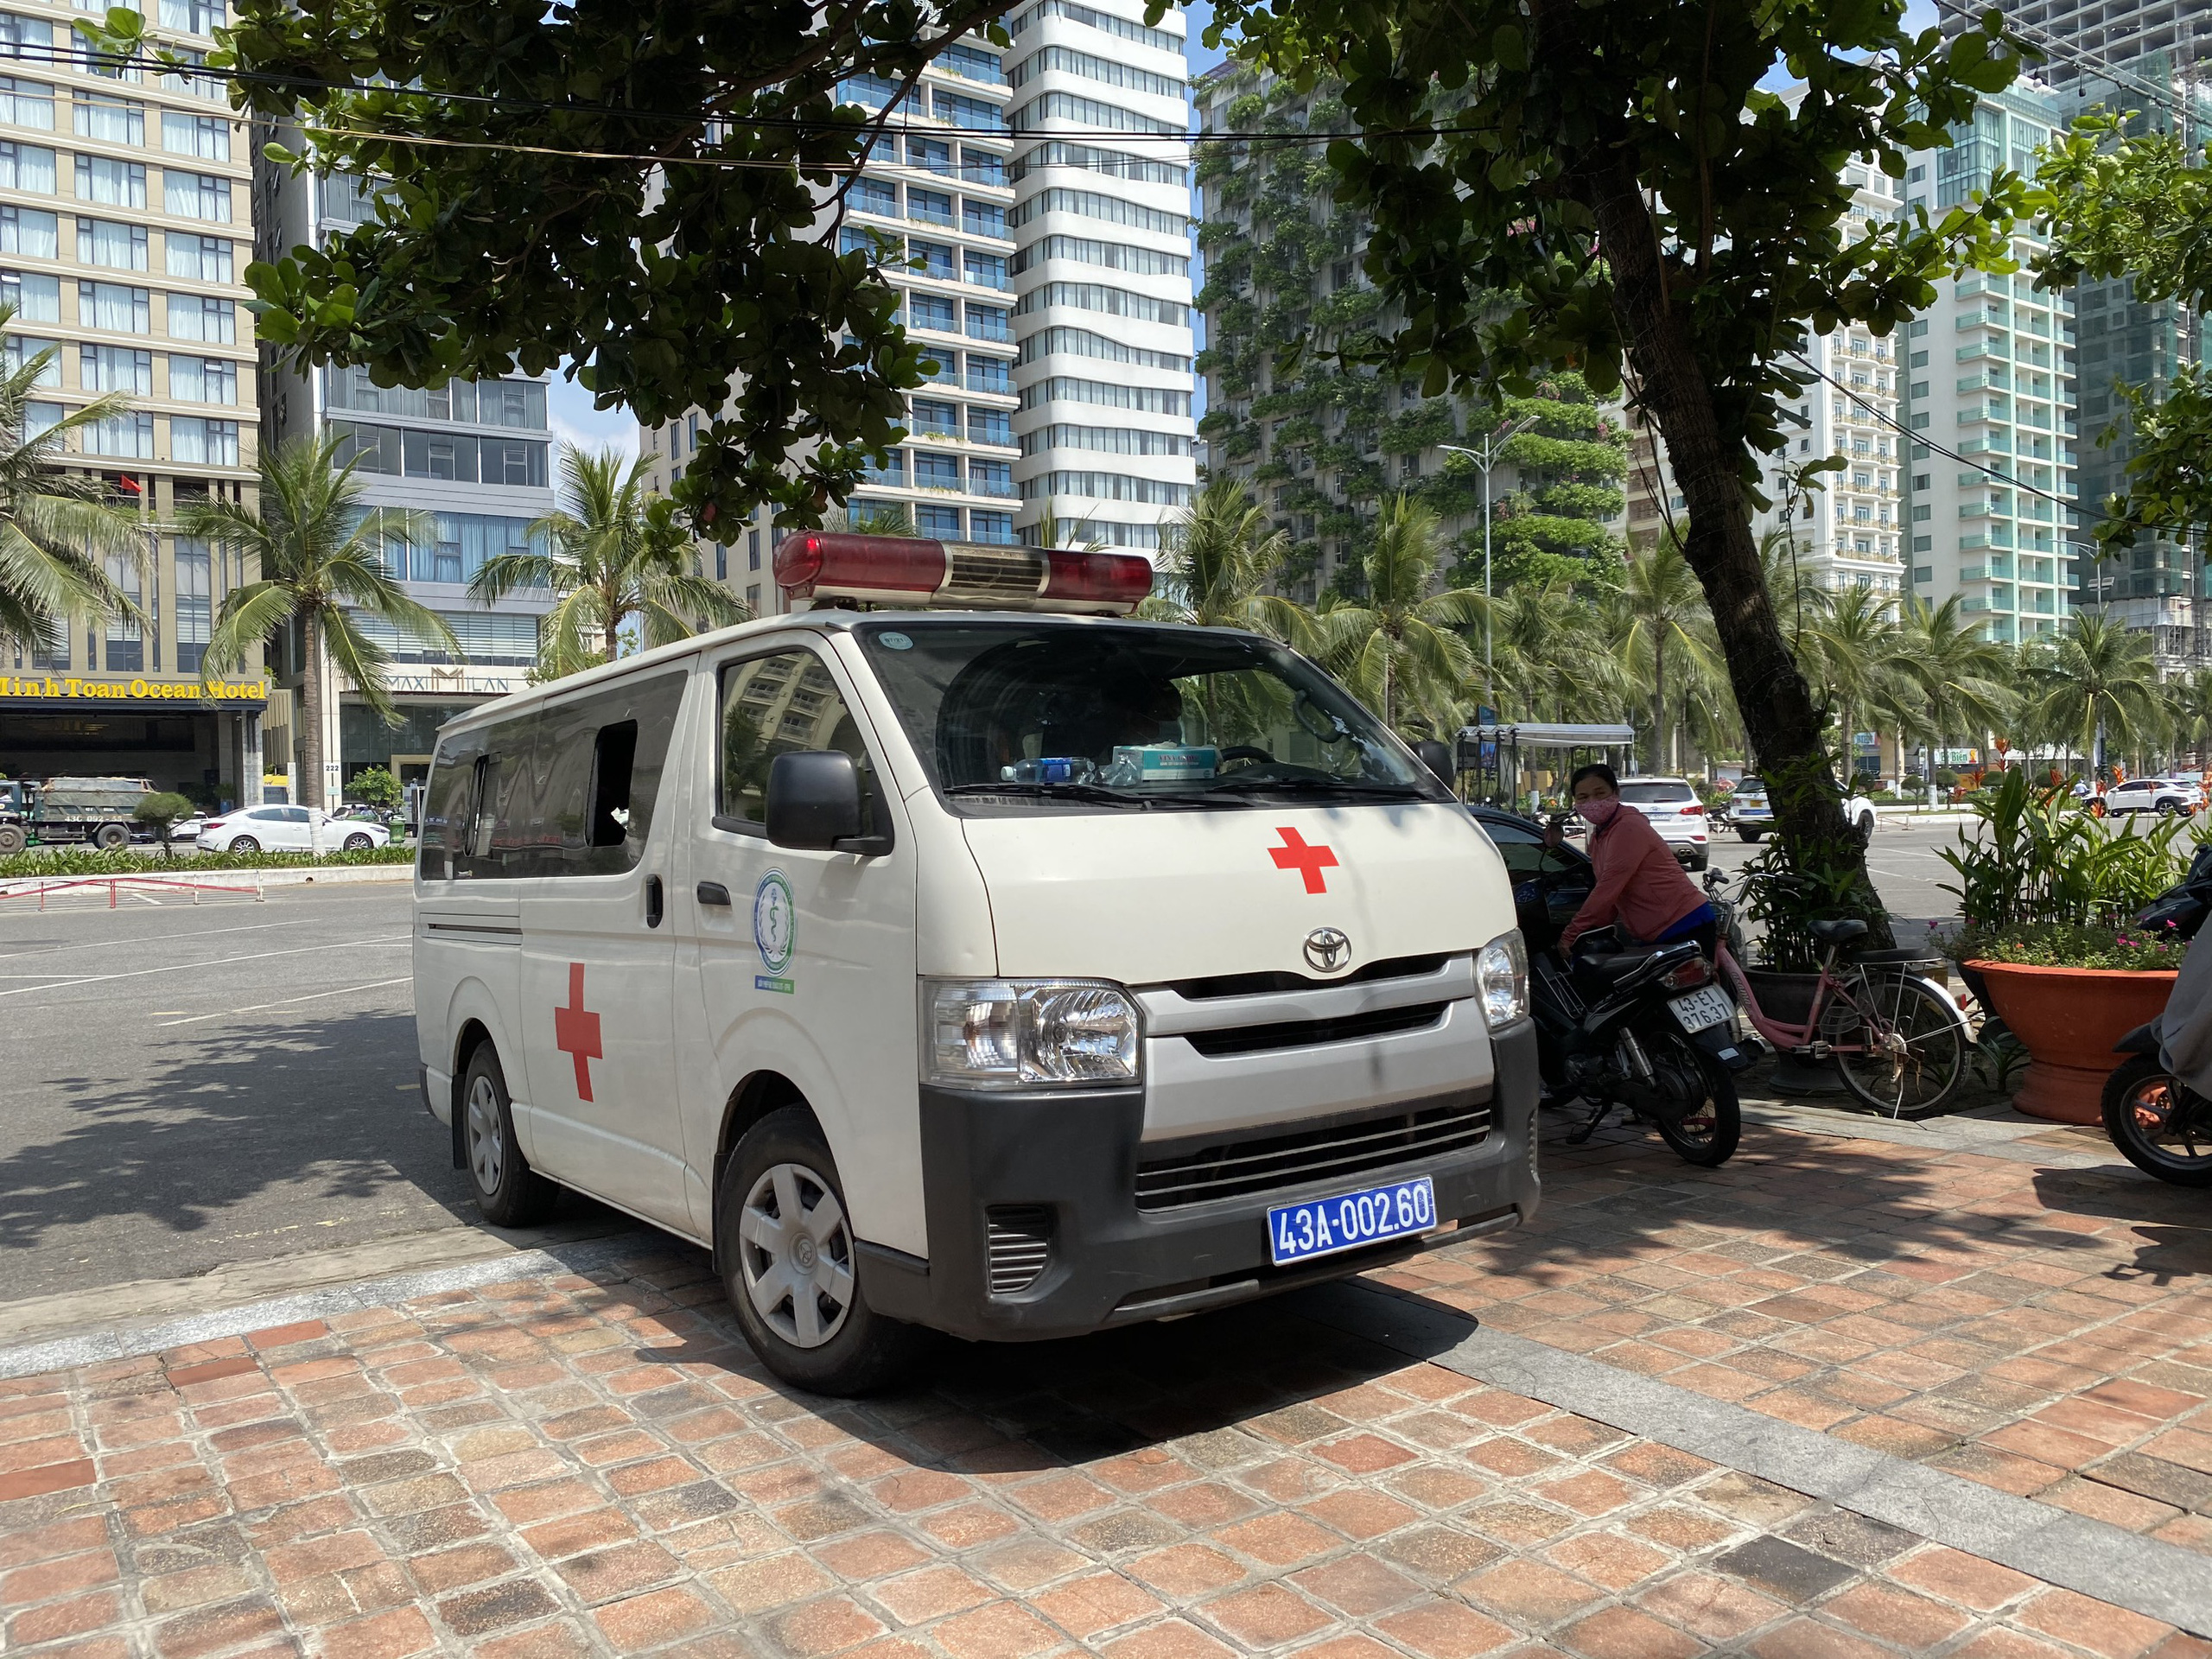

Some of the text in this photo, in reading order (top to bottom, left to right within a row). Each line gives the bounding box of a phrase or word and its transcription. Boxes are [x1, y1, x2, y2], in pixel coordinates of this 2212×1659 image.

[65, 678, 127, 698] Toan
[130, 679, 208, 698] Ocean
[207, 681, 266, 699] Hotel
[1677, 990, 1715, 1013] 43-E1
[1683, 1003, 1729, 1030] 376.37
[1279, 1185, 1430, 1254] 43A-002.60
